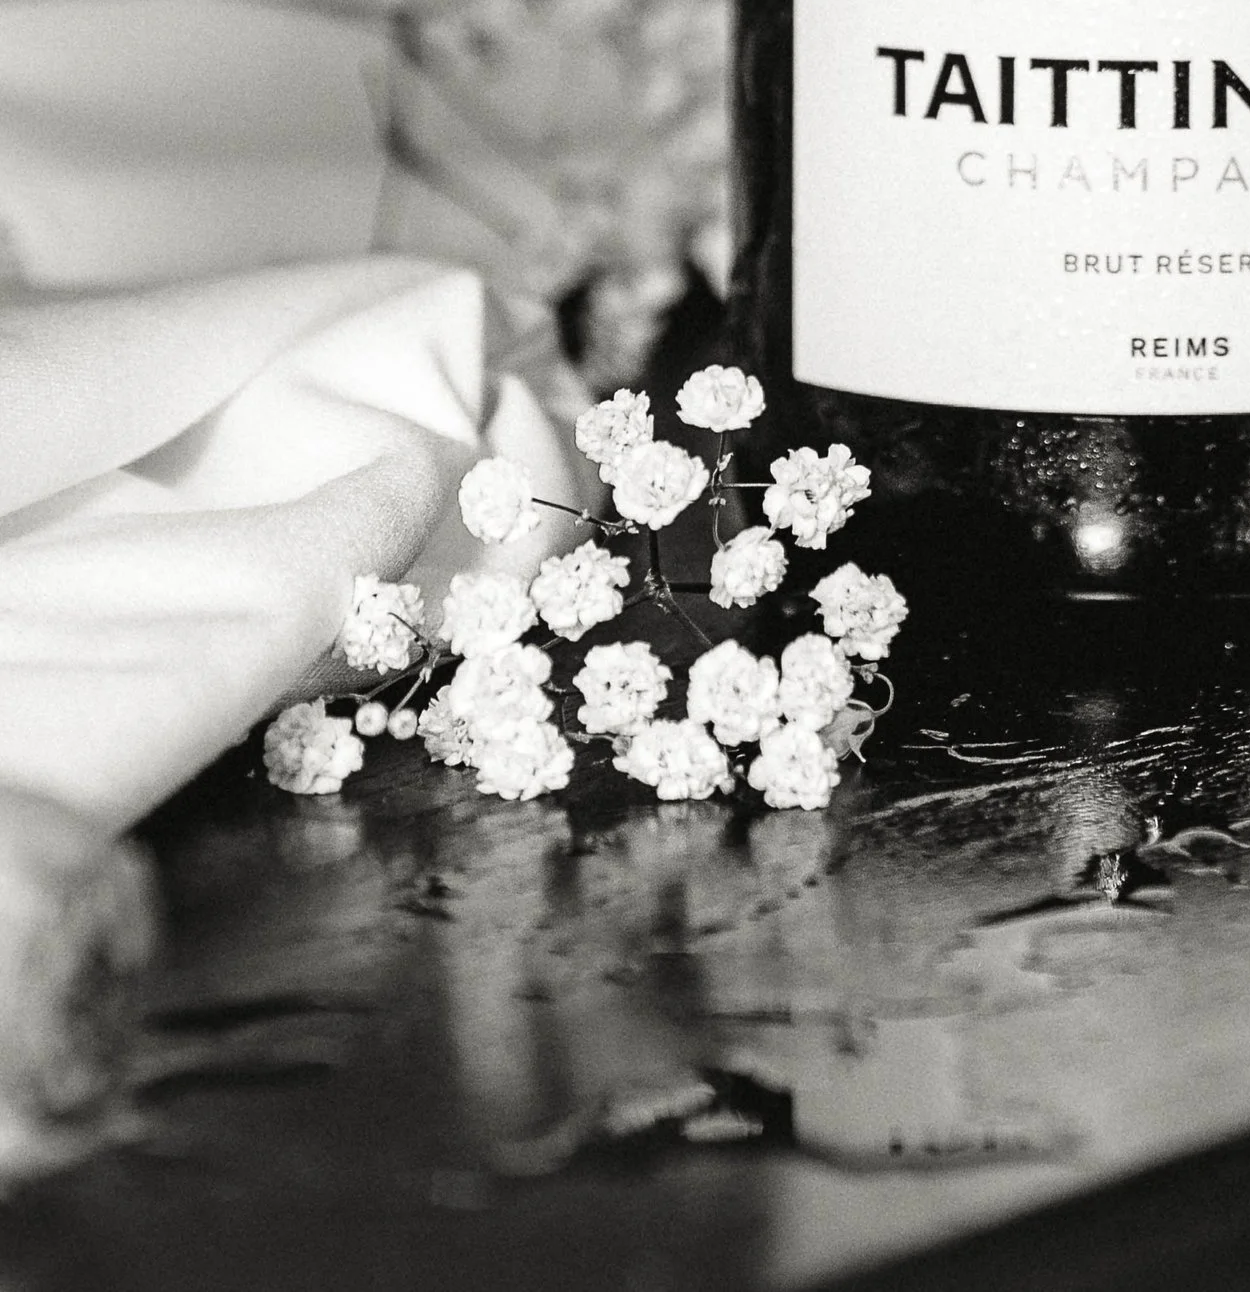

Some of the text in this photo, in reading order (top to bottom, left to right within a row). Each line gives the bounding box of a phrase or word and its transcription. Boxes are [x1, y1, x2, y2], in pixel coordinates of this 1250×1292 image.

[1063, 253, 1143, 274] BRUT
[1131, 337, 1230, 358] REIMS
[1135, 366, 1219, 381] FRANCE
